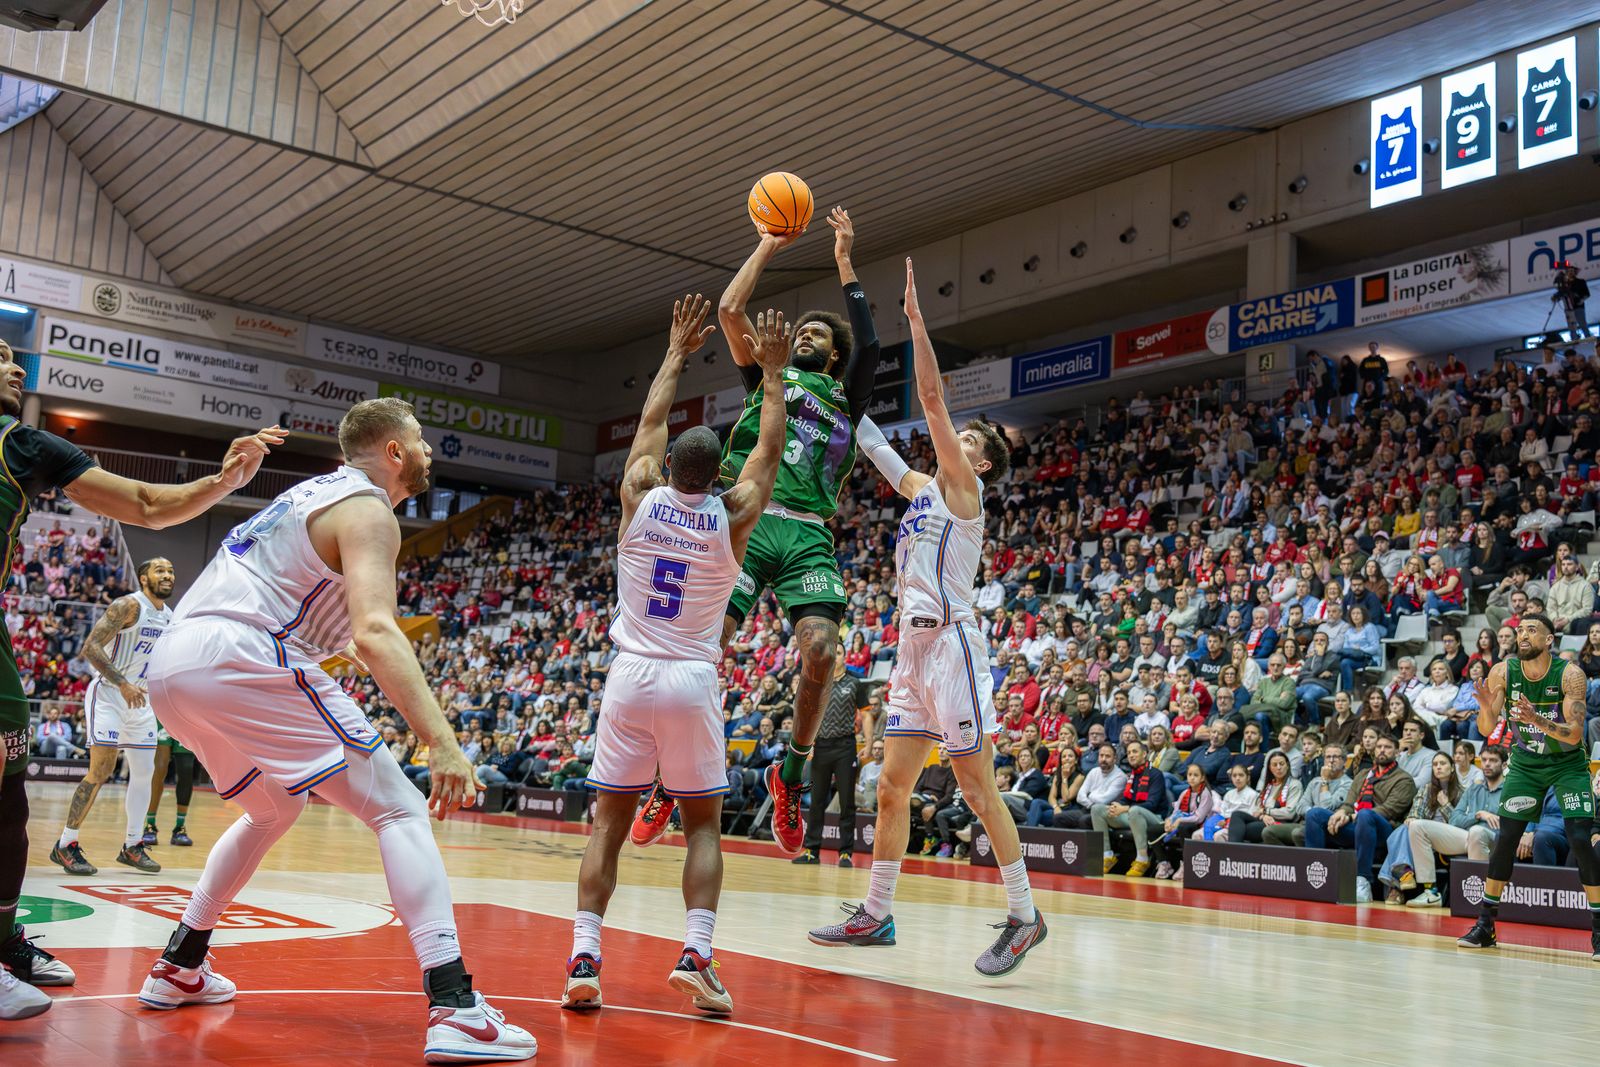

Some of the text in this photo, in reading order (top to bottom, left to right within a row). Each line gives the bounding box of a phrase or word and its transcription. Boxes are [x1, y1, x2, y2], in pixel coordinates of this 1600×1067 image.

[1535, 90, 1558, 123] 7
[1456, 114, 1480, 144] 9
[1387, 136, 1404, 165] 7
[1394, 253, 1470, 280] La DIGITAL
[1393, 277, 1456, 302] impser
[1238, 285, 1337, 321] CALSINA
[49, 323, 161, 365] Panella
[1136, 324, 1171, 350] Servei
[48, 367, 104, 393] Kave
[1026, 354, 1093, 384] mineralia
[201, 394, 262, 420] Home
[804, 396, 845, 430] Unicaja
[611, 420, 637, 441] Diari
[467, 445, 550, 469] Pirineu de Girona
[784, 440, 804, 465] 3
[648, 502, 718, 532] NEEDHAM
[644, 530, 709, 553] Kave Home
[644, 555, 690, 622] 5
[1027, 843, 1055, 859] GIRONA
[1219, 857, 1297, 882] BÀSQUET GIRONA
[1500, 882, 1555, 907] BÀSQUET
